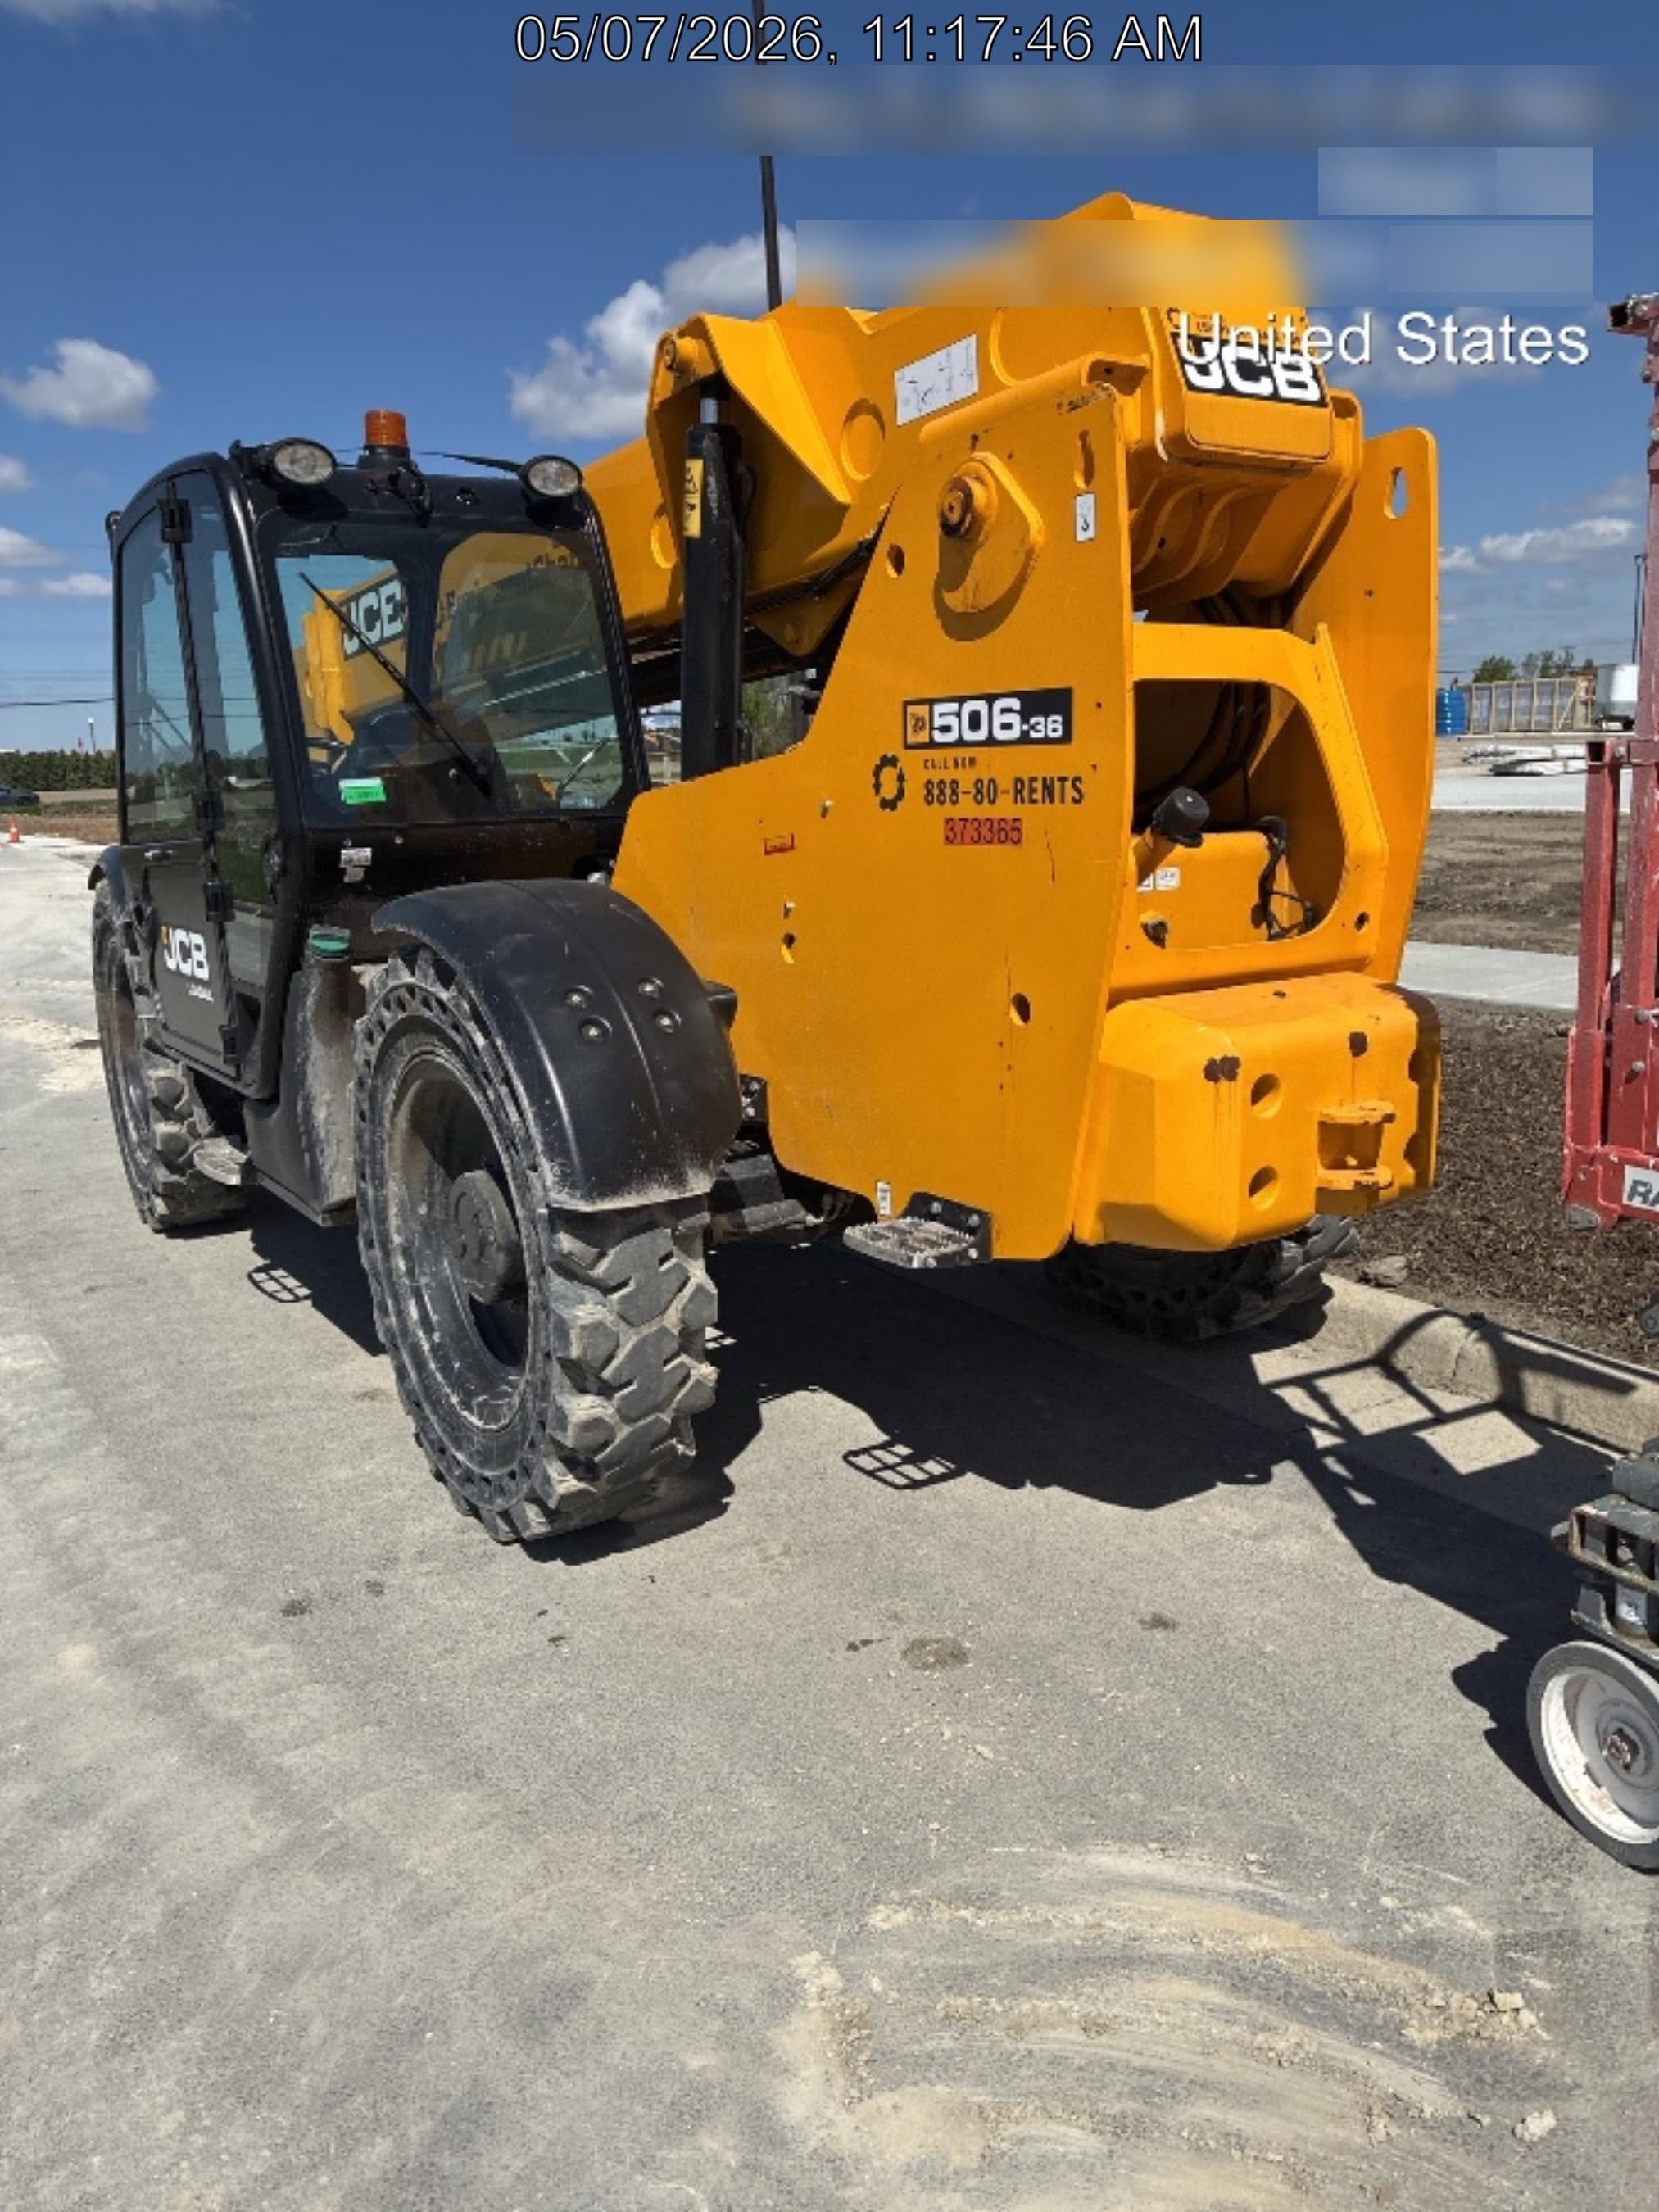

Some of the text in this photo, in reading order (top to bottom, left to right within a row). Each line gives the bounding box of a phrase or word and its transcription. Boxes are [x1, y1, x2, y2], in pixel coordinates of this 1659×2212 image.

[1185, 338, 1321, 402] JCB
[923, 776, 1085, 805] 888-80-RENTS
[945, 818, 1022, 845] 373365
[164, 926, 210, 981] JCB
